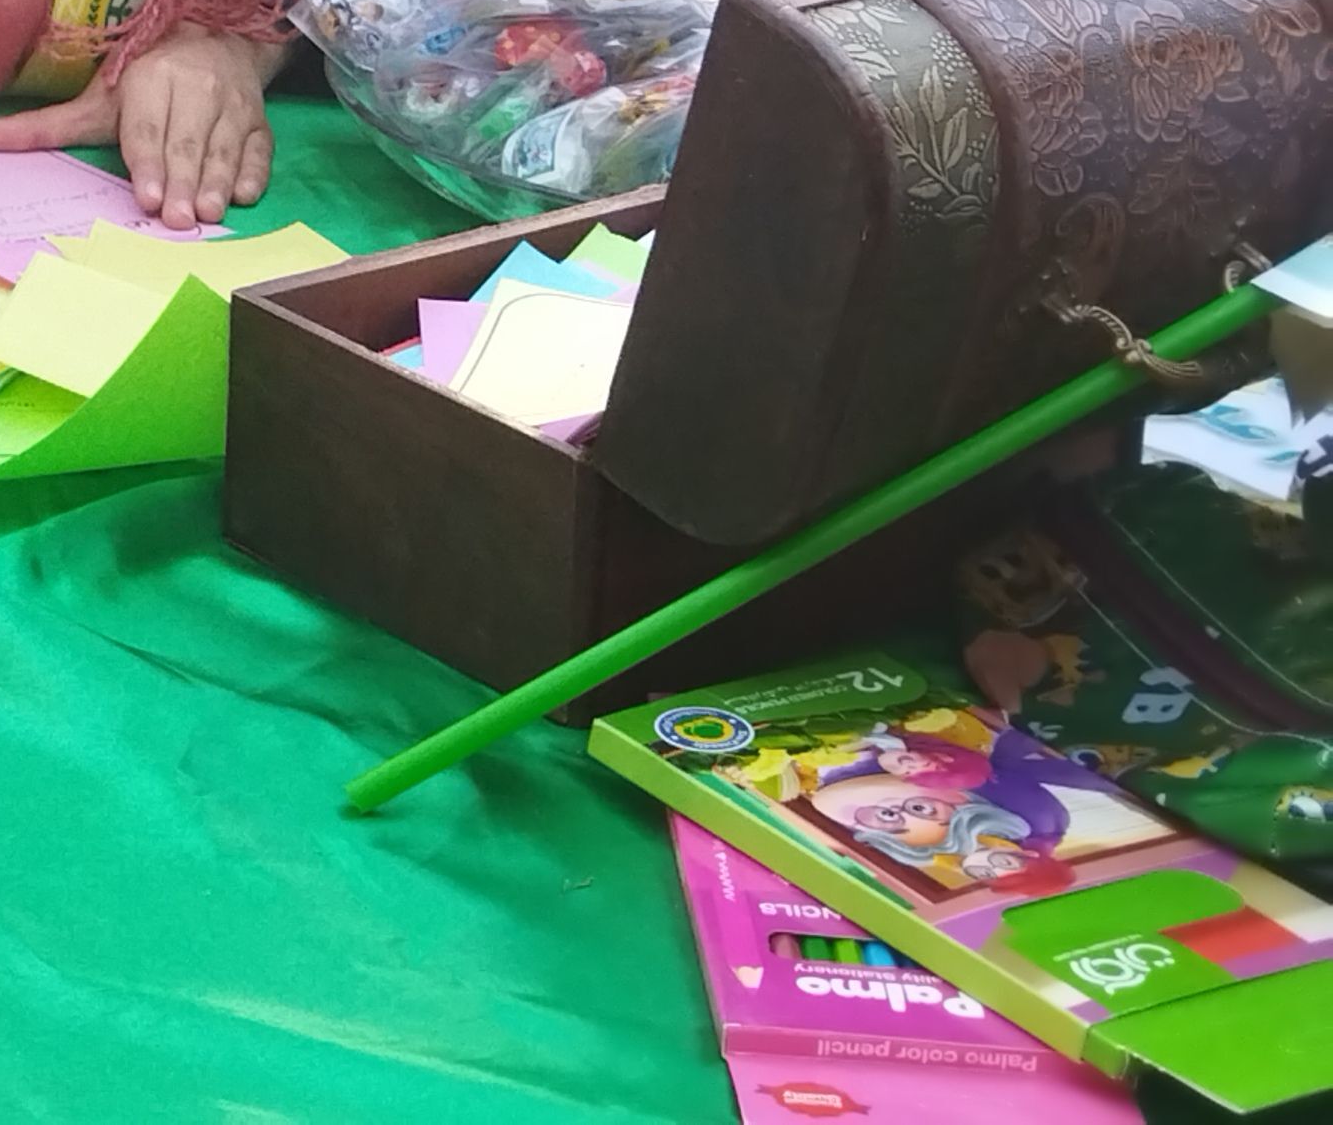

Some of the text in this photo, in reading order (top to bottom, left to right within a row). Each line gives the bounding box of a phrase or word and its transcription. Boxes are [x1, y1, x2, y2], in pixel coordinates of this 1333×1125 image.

[836, 667, 904, 693] 12
[759, 901, 843, 921] NCILS
[795, 976, 985, 1019] Palmo
[817, 1038, 1039, 1073] Palmo color pencil
